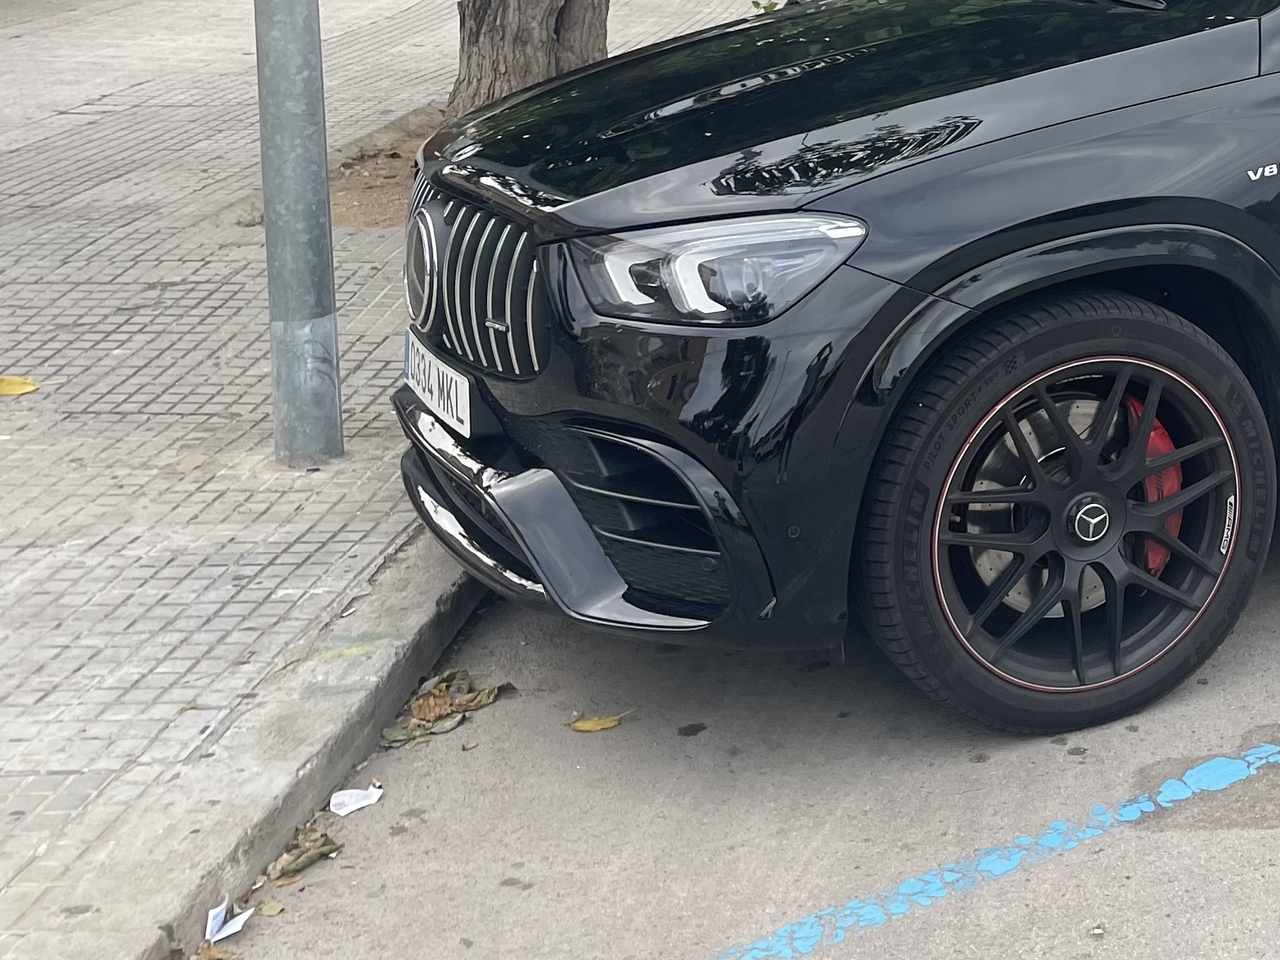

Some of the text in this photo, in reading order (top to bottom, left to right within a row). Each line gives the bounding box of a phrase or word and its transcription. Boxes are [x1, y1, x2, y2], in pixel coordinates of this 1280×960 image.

[1246, 163, 1278, 181] V8
[410, 340, 465, 426] 0334 MKL
[923, 431, 946, 471] PILOT
[946, 391, 978, 431] SPORT
[1242, 418, 1267, 554] MICHELIN
[903, 489, 934, 636] MICHELIN
